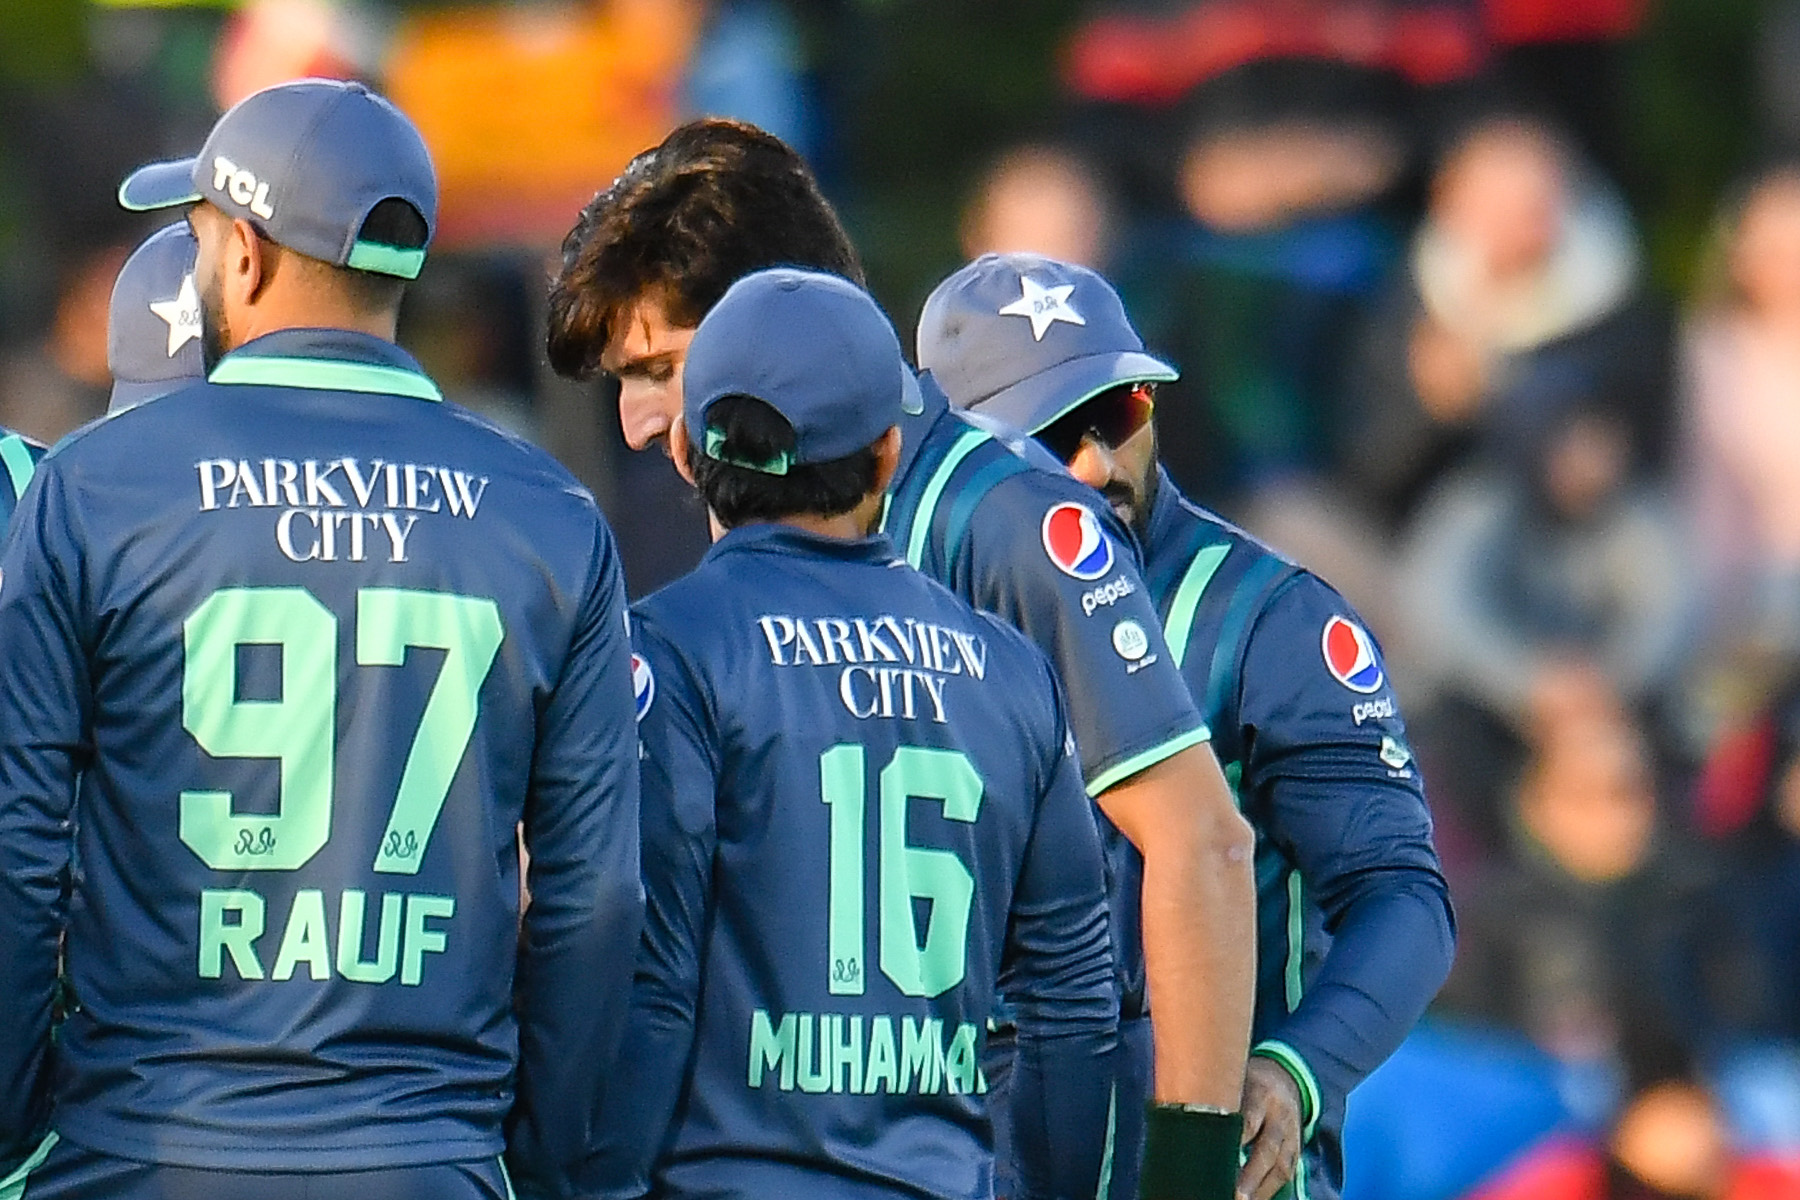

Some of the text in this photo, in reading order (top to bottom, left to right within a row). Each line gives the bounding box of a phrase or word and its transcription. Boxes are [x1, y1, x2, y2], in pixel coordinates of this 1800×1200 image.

[213, 156, 275, 221] TCL
[194, 457, 490, 520] PARKVIEW
[277, 508, 419, 562] CITY
[1081, 574, 1131, 617] pepsi
[757, 615, 987, 680] PARKVIEW
[840, 665, 949, 723] CITY
[179, 586, 504, 875] 97
[819, 743, 984, 999] 16
[198, 889, 455, 986] RAUF
